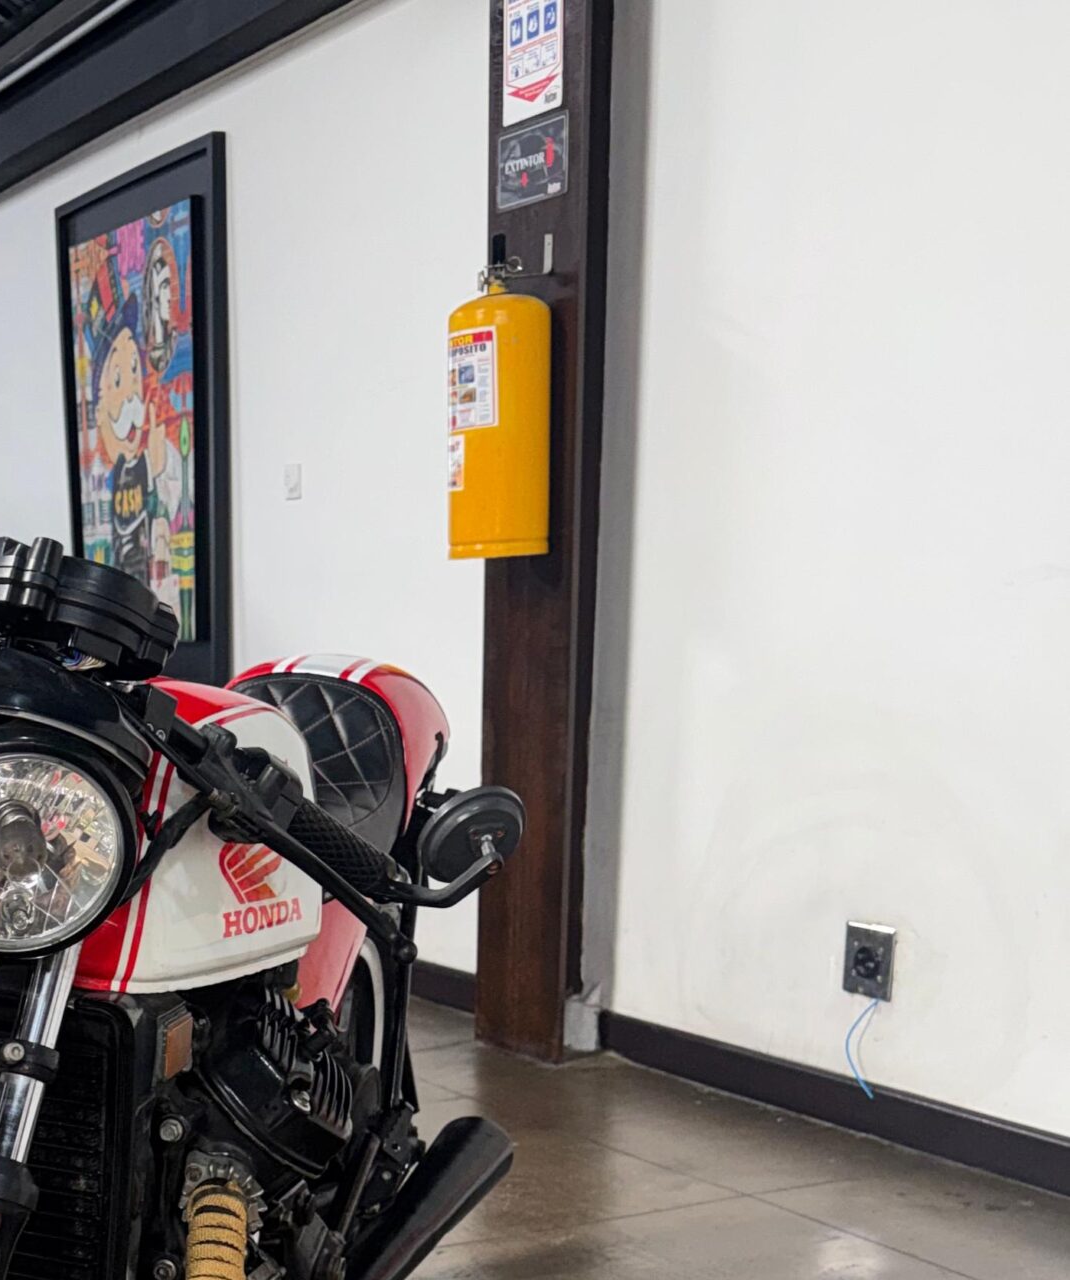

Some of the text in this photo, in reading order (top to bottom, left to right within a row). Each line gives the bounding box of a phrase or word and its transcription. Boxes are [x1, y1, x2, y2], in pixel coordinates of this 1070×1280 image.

[505, 151, 545, 175] EXTINTOR
[114, 484, 143, 518] CASH
[223, 898, 302, 938] HONDA
